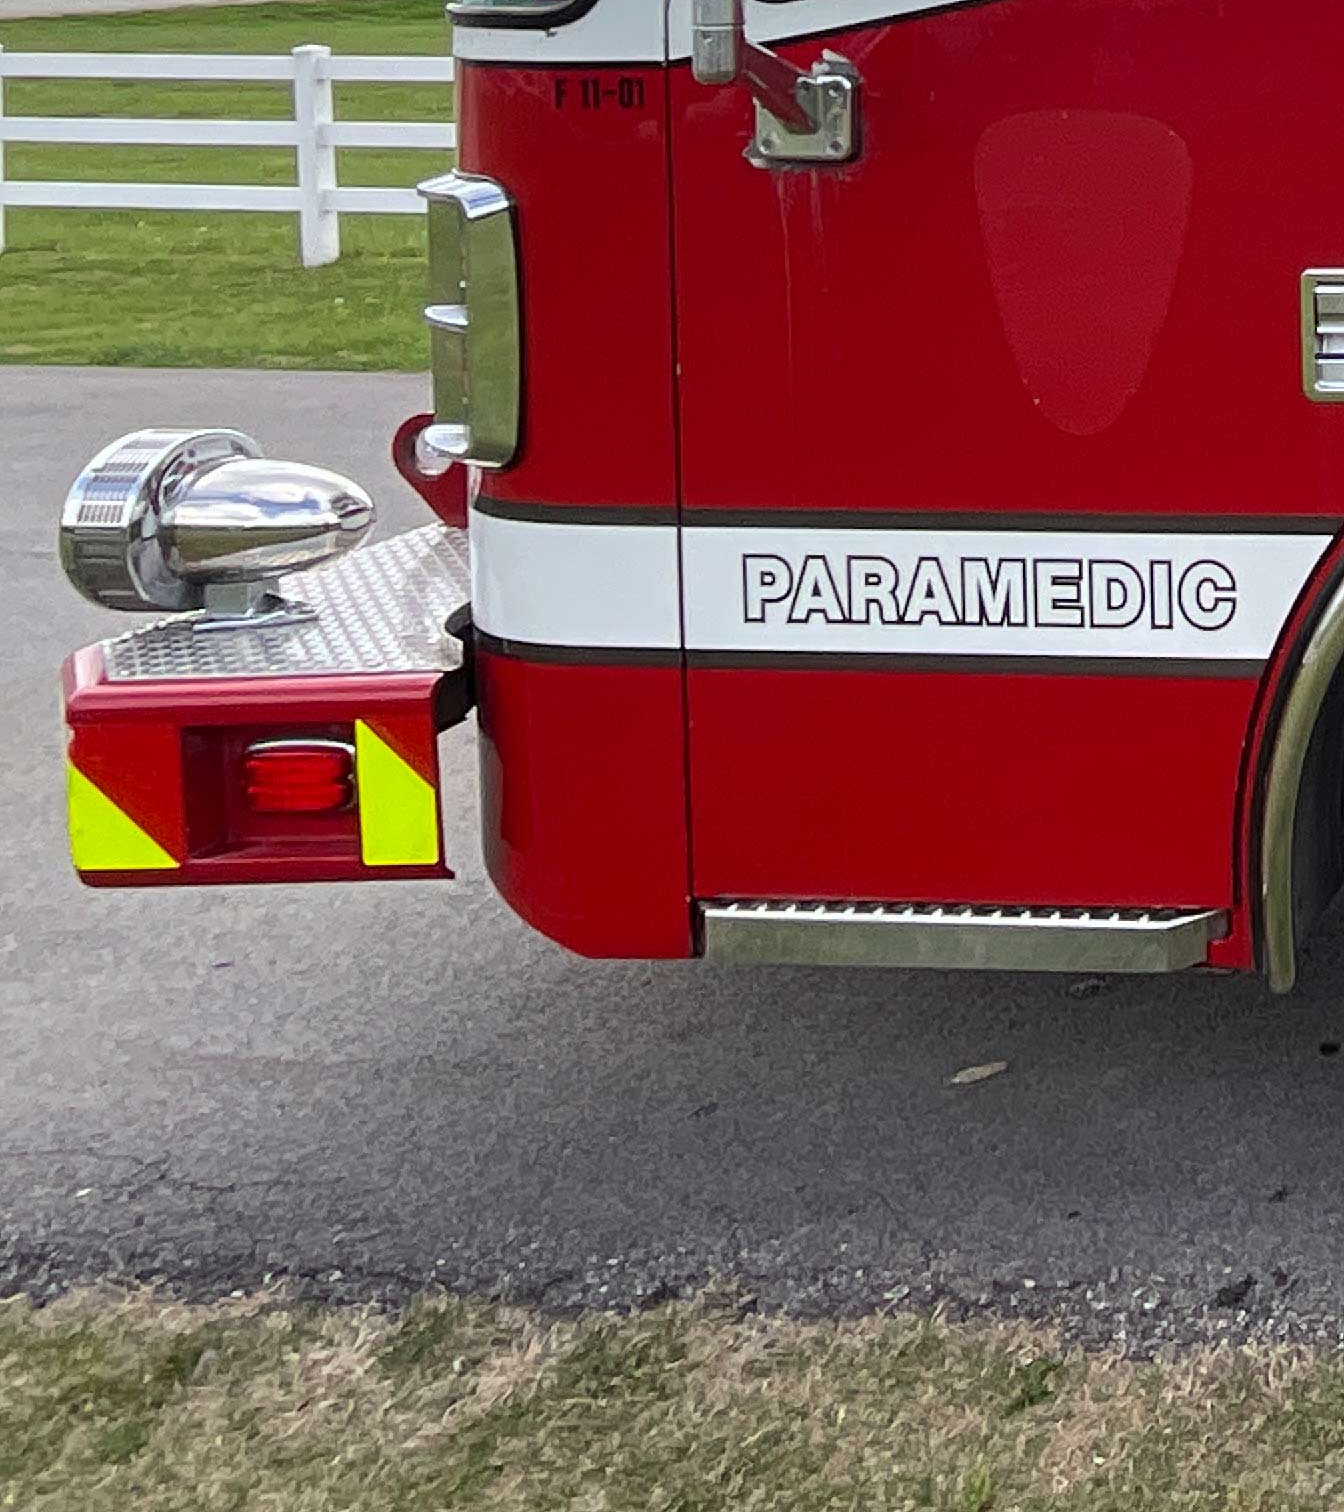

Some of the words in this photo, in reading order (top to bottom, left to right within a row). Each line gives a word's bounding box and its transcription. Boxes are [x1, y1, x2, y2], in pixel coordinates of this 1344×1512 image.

[554, 78, 567, 110] F
[581, 77, 645, 110] 11-01
[741, 553, 1238, 631] PARAMEDIC
